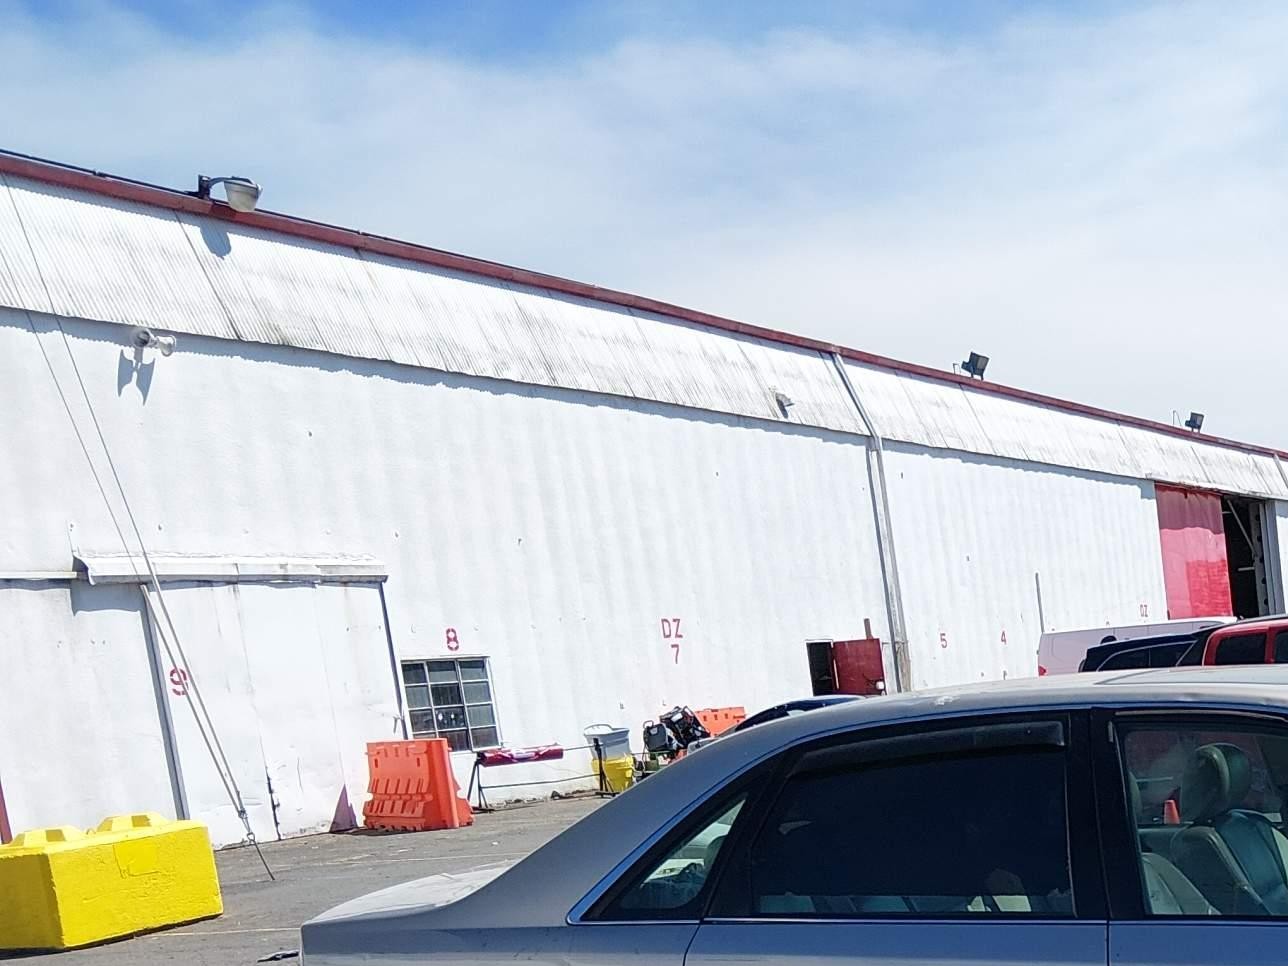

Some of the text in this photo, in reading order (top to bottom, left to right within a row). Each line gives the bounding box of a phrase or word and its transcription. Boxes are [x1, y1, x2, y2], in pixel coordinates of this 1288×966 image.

[660, 618, 683, 638] DZ
[1000, 630, 1007, 645] 4
[446, 628, 459, 651] 8
[940, 632, 948, 649] 5
[670, 643, 680, 665] 7
[169, 668, 189, 696] 9
